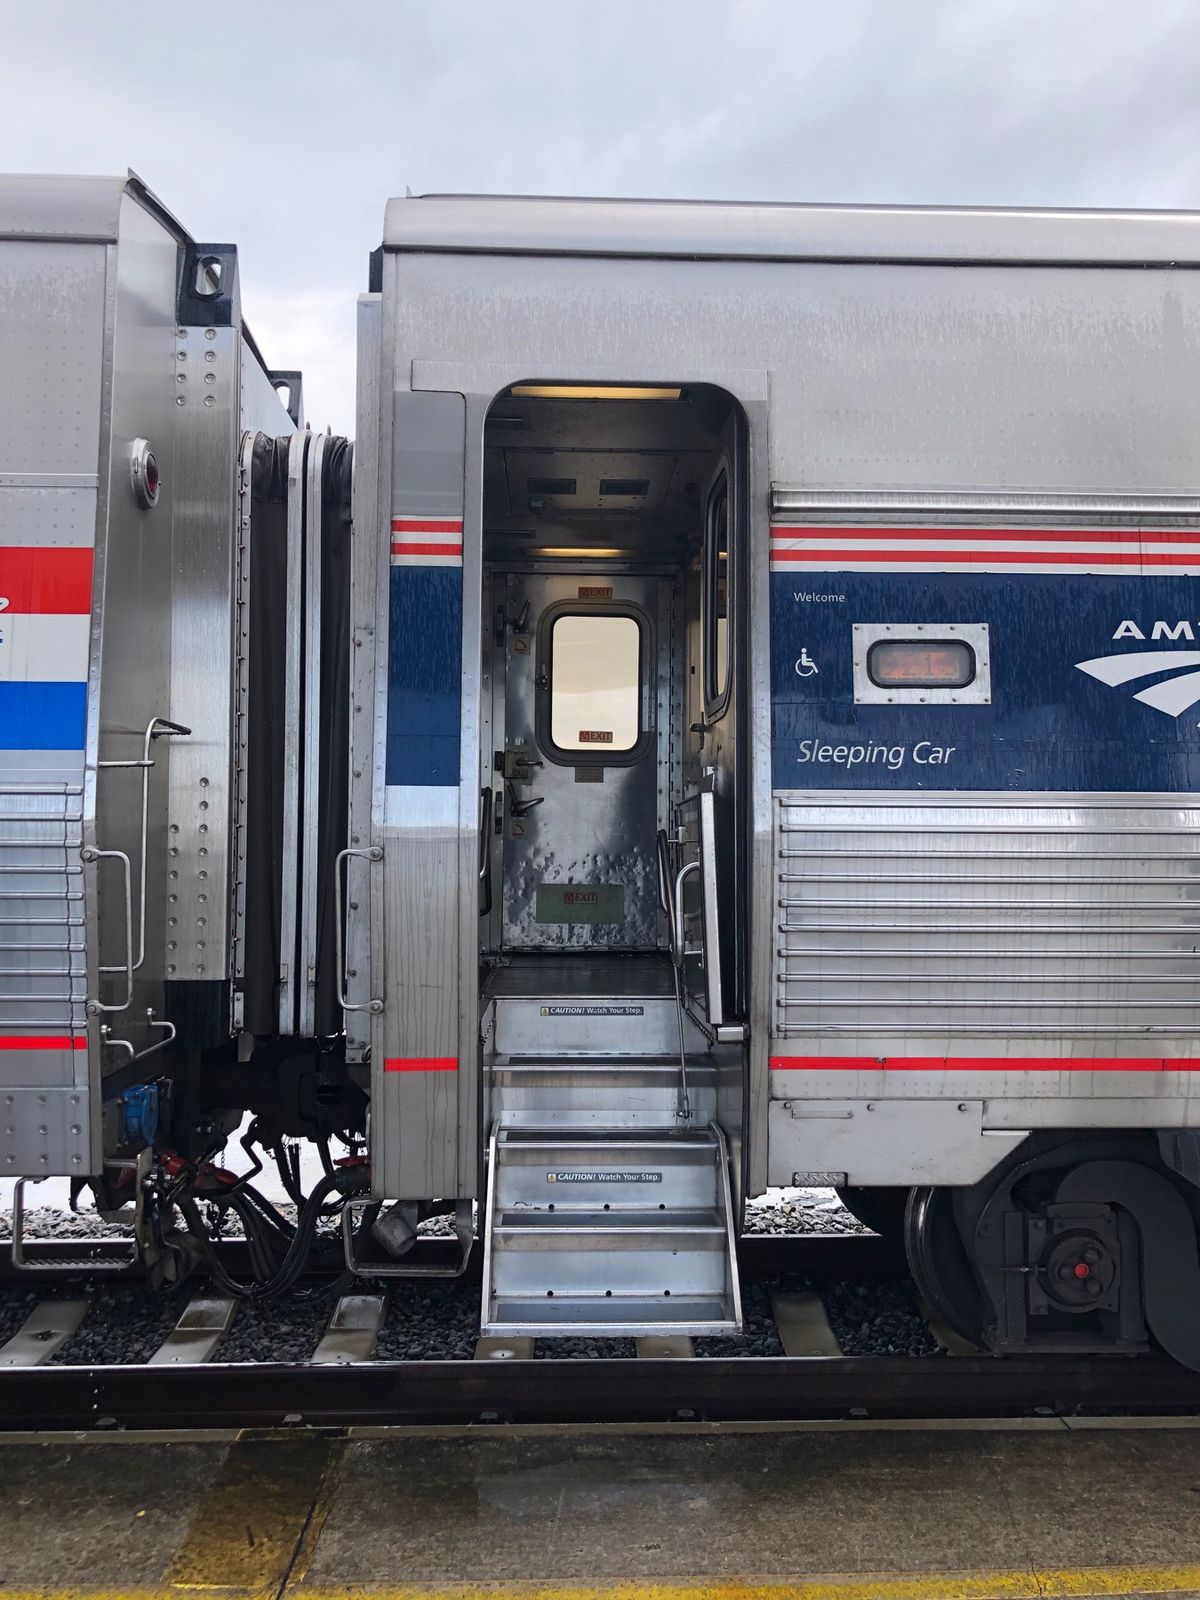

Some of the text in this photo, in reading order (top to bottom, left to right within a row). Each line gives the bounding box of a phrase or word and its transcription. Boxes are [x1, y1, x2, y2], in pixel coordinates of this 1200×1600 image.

[793, 591, 845, 602] Welcome
[1111, 620, 1200, 640] AM
[797, 739, 956, 770] Sleeping Car
[598, 1173, 621, 1181] Watch
[623, 1173, 639, 1181] Your
[641, 1173, 660, 1182] Step.
